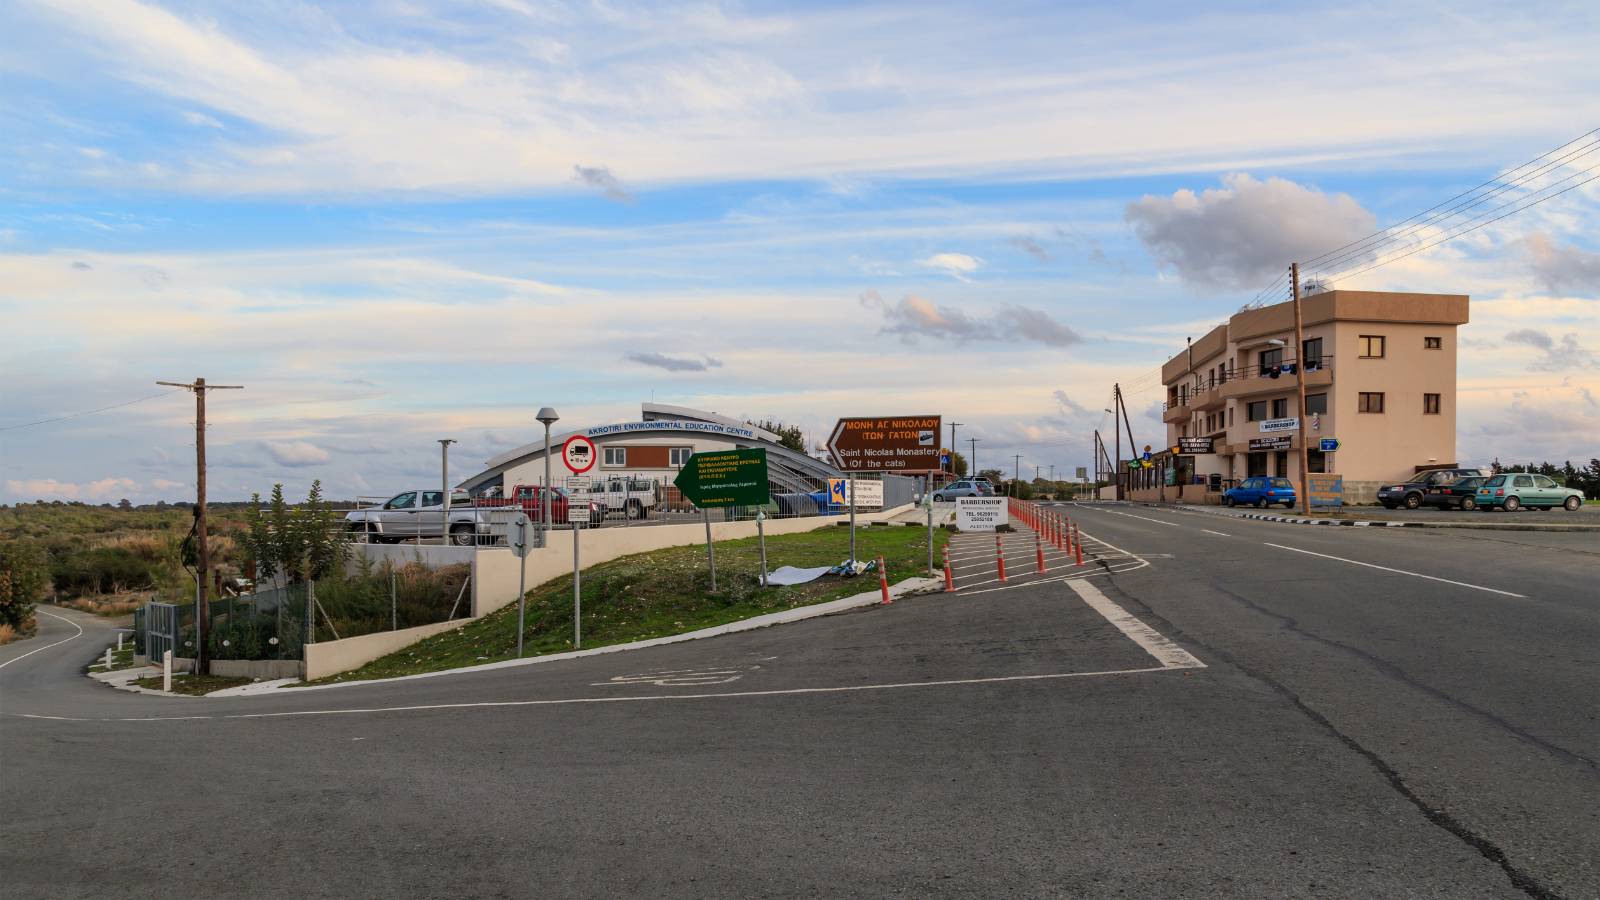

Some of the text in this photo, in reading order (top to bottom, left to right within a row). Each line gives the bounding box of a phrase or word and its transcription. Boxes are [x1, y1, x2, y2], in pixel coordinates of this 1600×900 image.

[588, 421, 753, 437] AKROTIRI ENVIRONMENTAL EDUCATION CENTRE
[846, 421, 873, 430] ΜΟΝΗ
[892, 419, 939, 429] ΝΙΚΟΛΑΟΥ
[840, 447, 940, 458] Saint Nicolas Monastery
[849, 459, 906, 468] (Of the cats)
